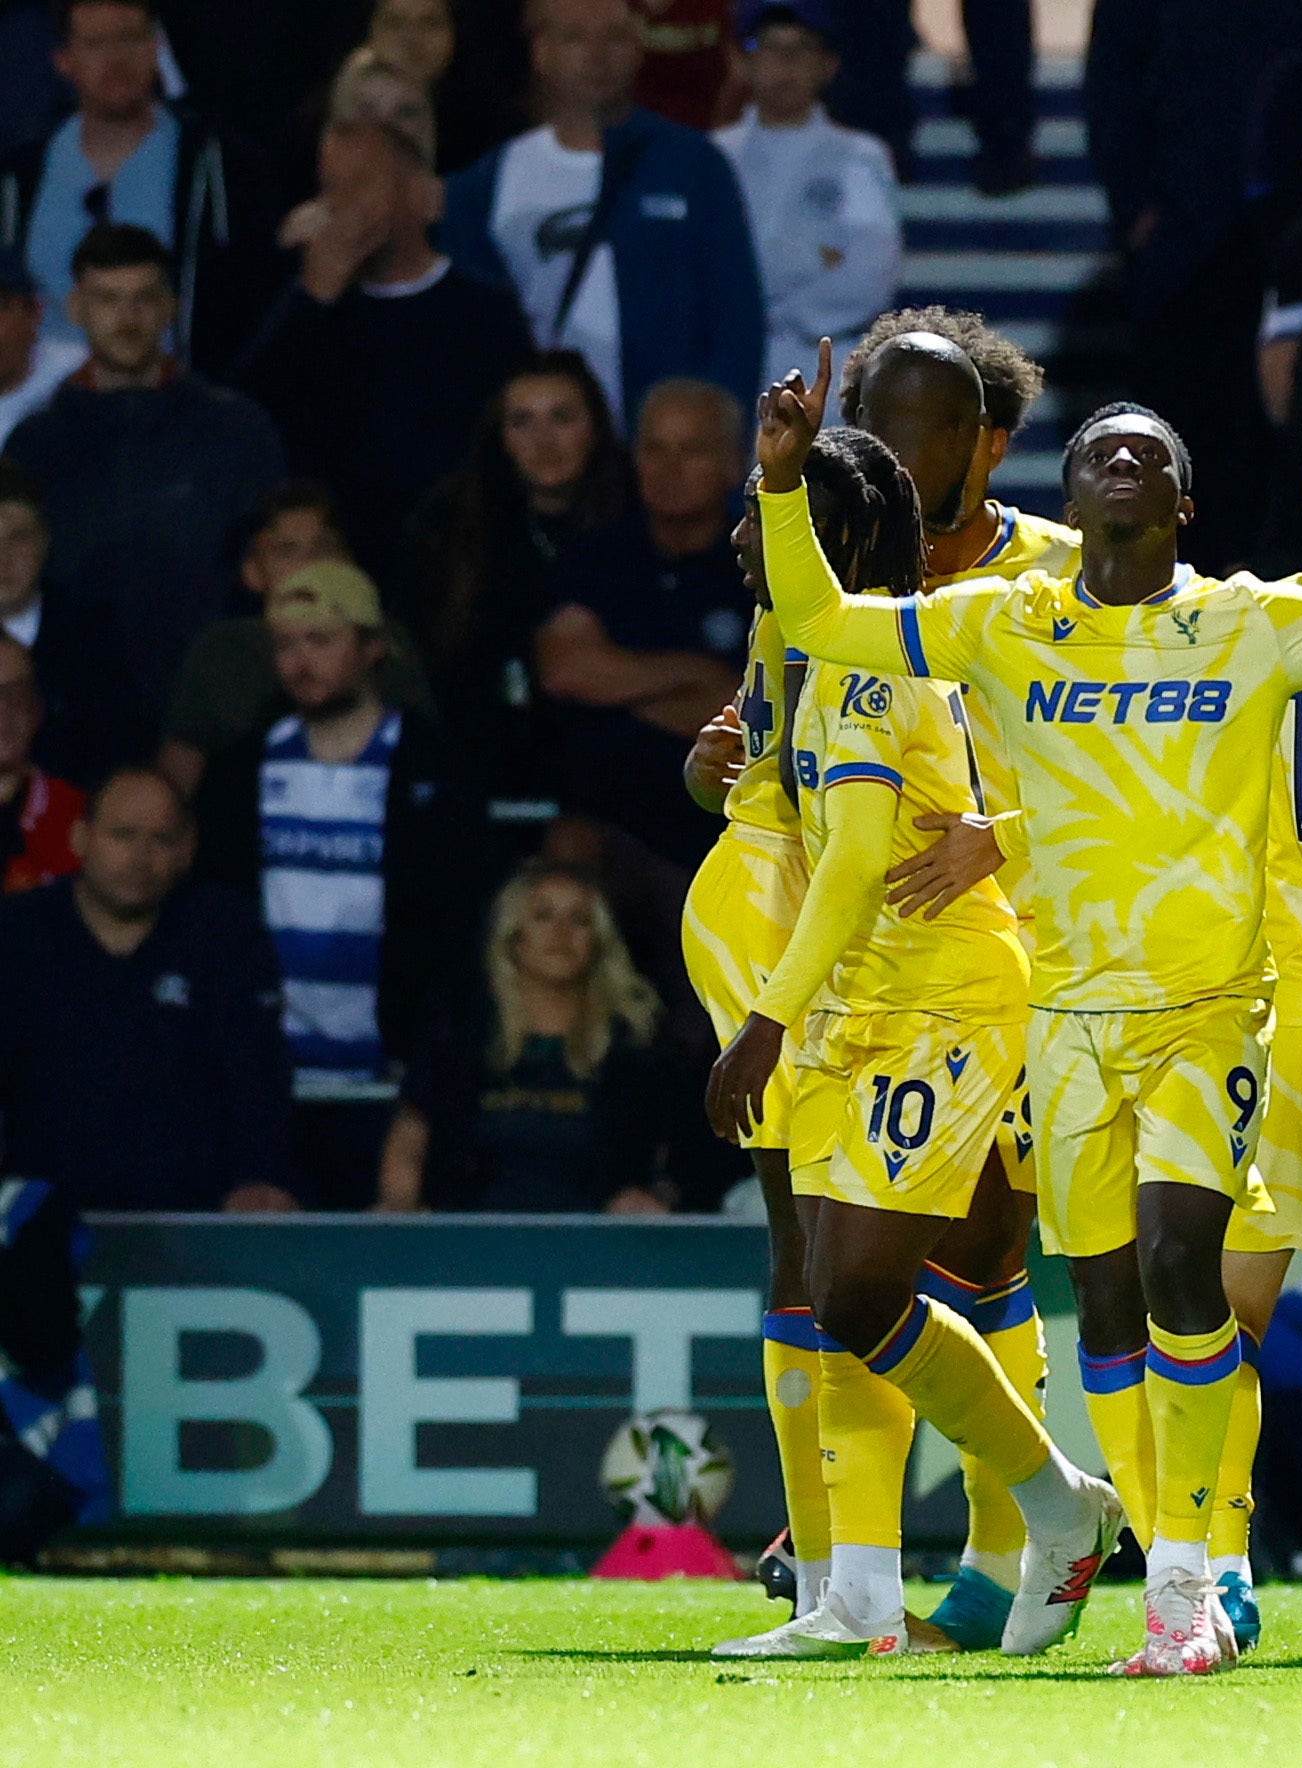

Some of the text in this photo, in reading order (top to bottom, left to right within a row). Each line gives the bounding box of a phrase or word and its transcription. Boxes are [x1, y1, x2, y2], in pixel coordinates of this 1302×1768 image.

[1026, 681, 1232, 724] NET88
[868, 1075, 936, 1149] 10
[1226, 1066, 1257, 1133] 9
